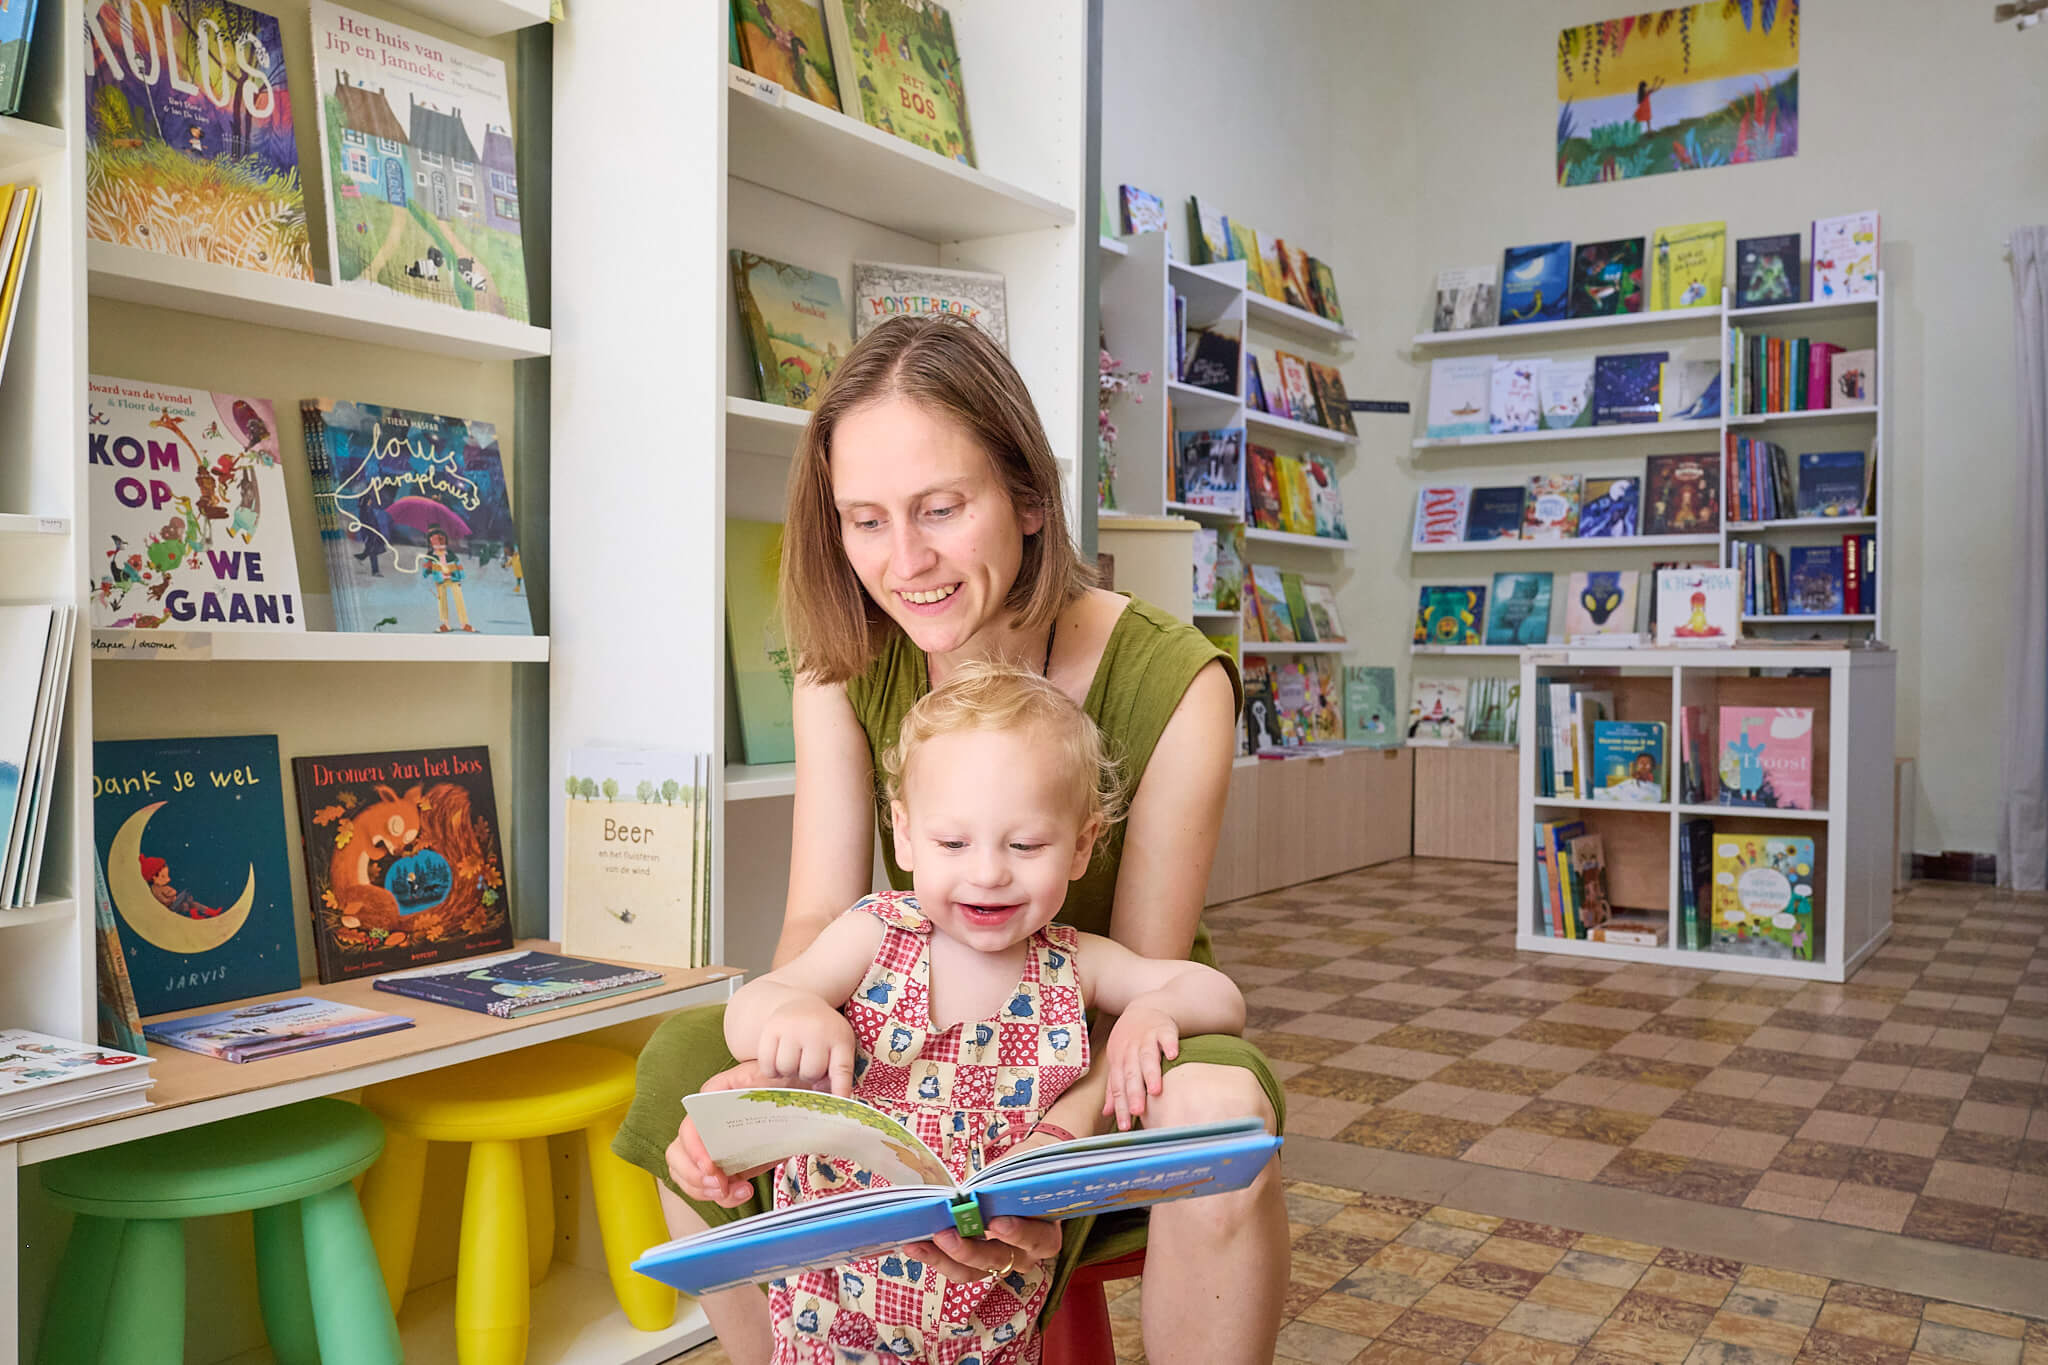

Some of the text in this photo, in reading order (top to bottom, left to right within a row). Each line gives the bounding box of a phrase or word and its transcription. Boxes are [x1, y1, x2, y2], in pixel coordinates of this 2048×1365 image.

[339, 15, 444, 63] Het huis van
[326, 31, 351, 55] Jip
[355, 44, 376, 60] en
[380, 49, 445, 81] Janneke
[902, 72, 925, 92] HET
[898, 85, 936, 120] BOS
[869, 296, 980, 322] MONSTERBOEK
[118, 399, 145, 411] Floor
[148, 403, 160, 413] de
[122, 388, 141, 397] van
[143, 389, 155, 400] de
[158, 392, 192, 405] Vendel
[89, 433, 181, 473] KOM
[115, 476, 173, 511] OP
[206, 550, 264, 582] WE
[165, 589, 294, 624] GAAN!
[139, 640, 176, 649] dromen
[313, 755, 483, 786] Dromen van het bos
[604, 818, 654, 844] Beer
[166, 965, 226, 991] JARVIS
